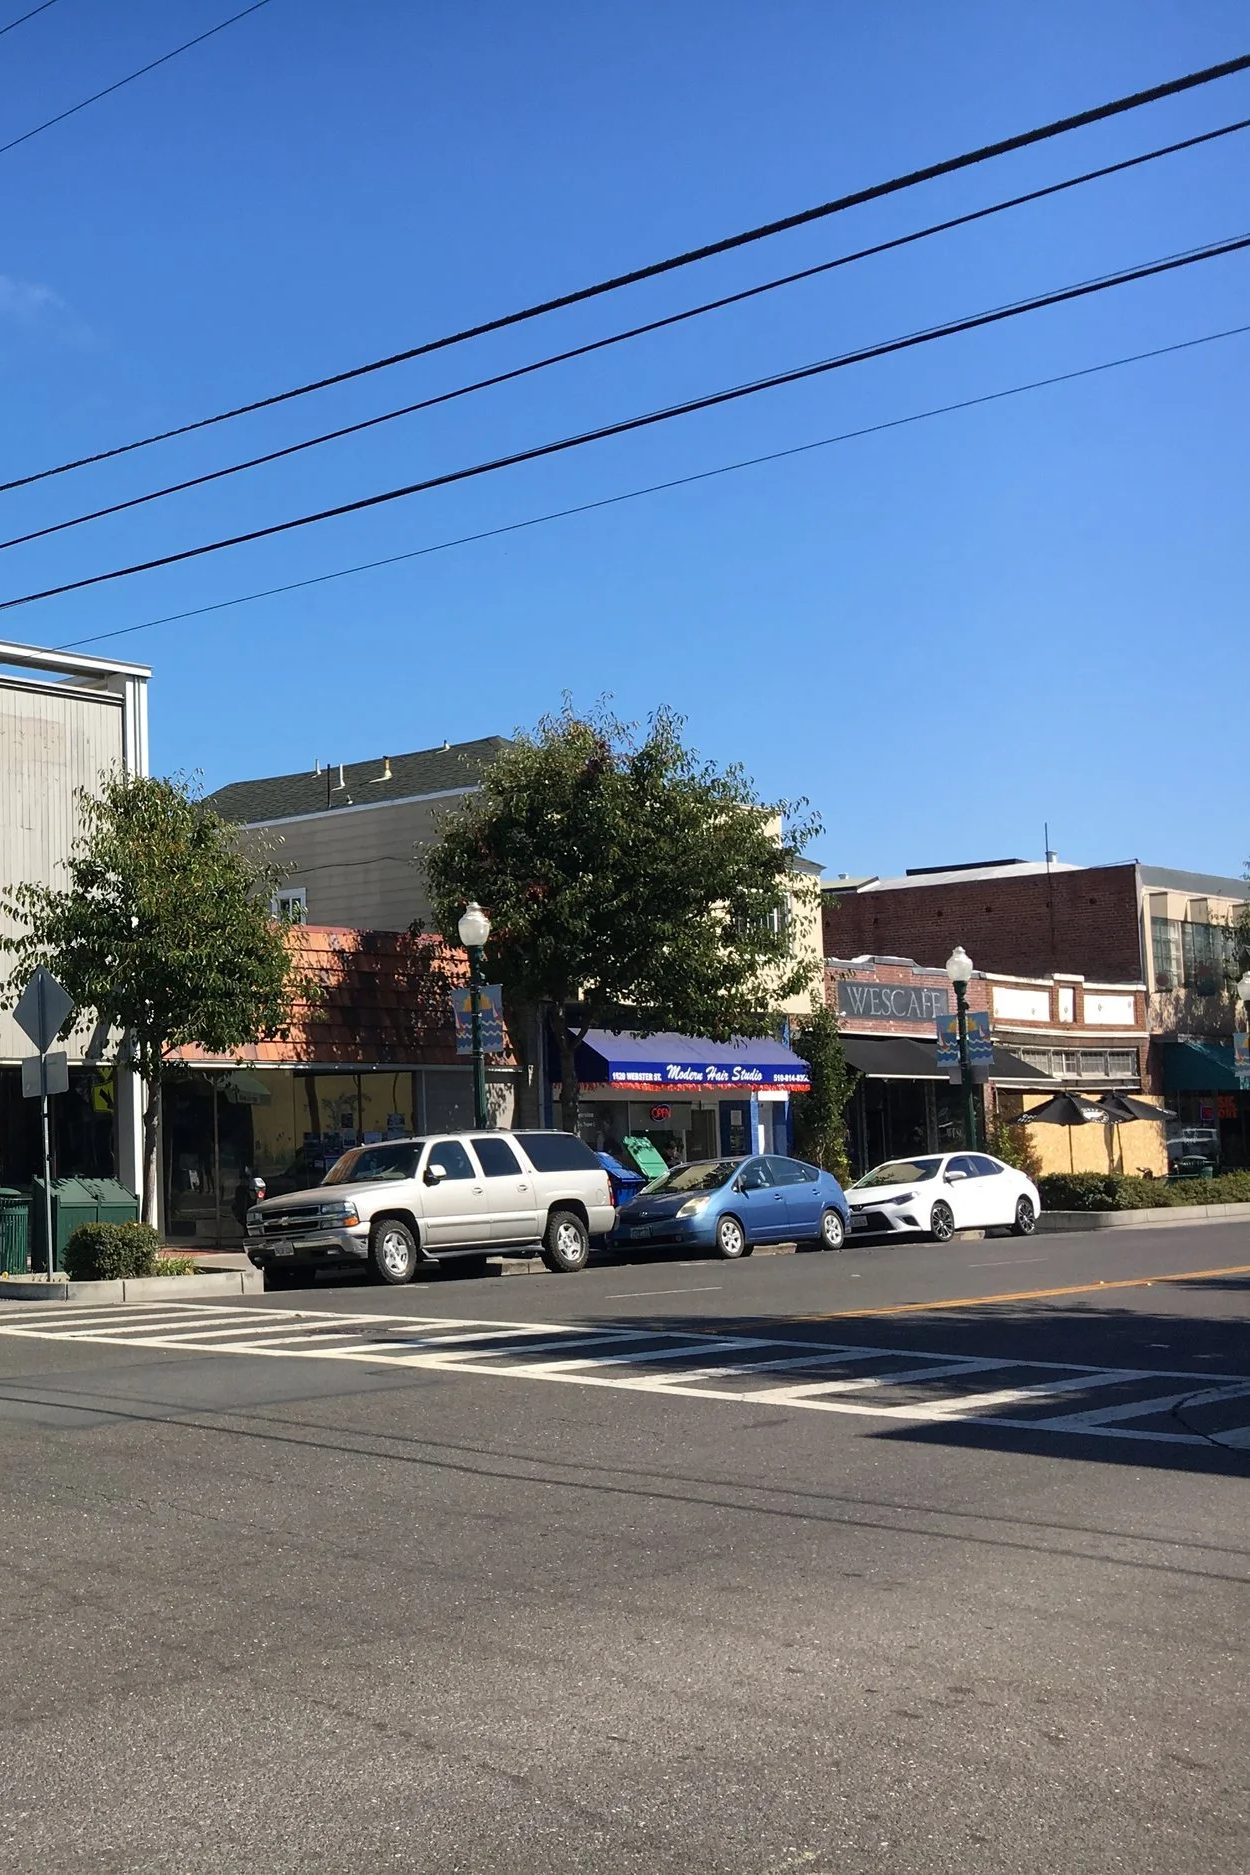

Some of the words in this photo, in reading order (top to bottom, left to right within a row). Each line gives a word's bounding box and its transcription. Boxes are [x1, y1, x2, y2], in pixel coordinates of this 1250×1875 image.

[626, 1072, 654, 1081] WEBSTER
[666, 1064, 703, 1081] Modern
[706, 1066, 729, 1081] Hair
[731, 1066, 763, 1081] Studio
